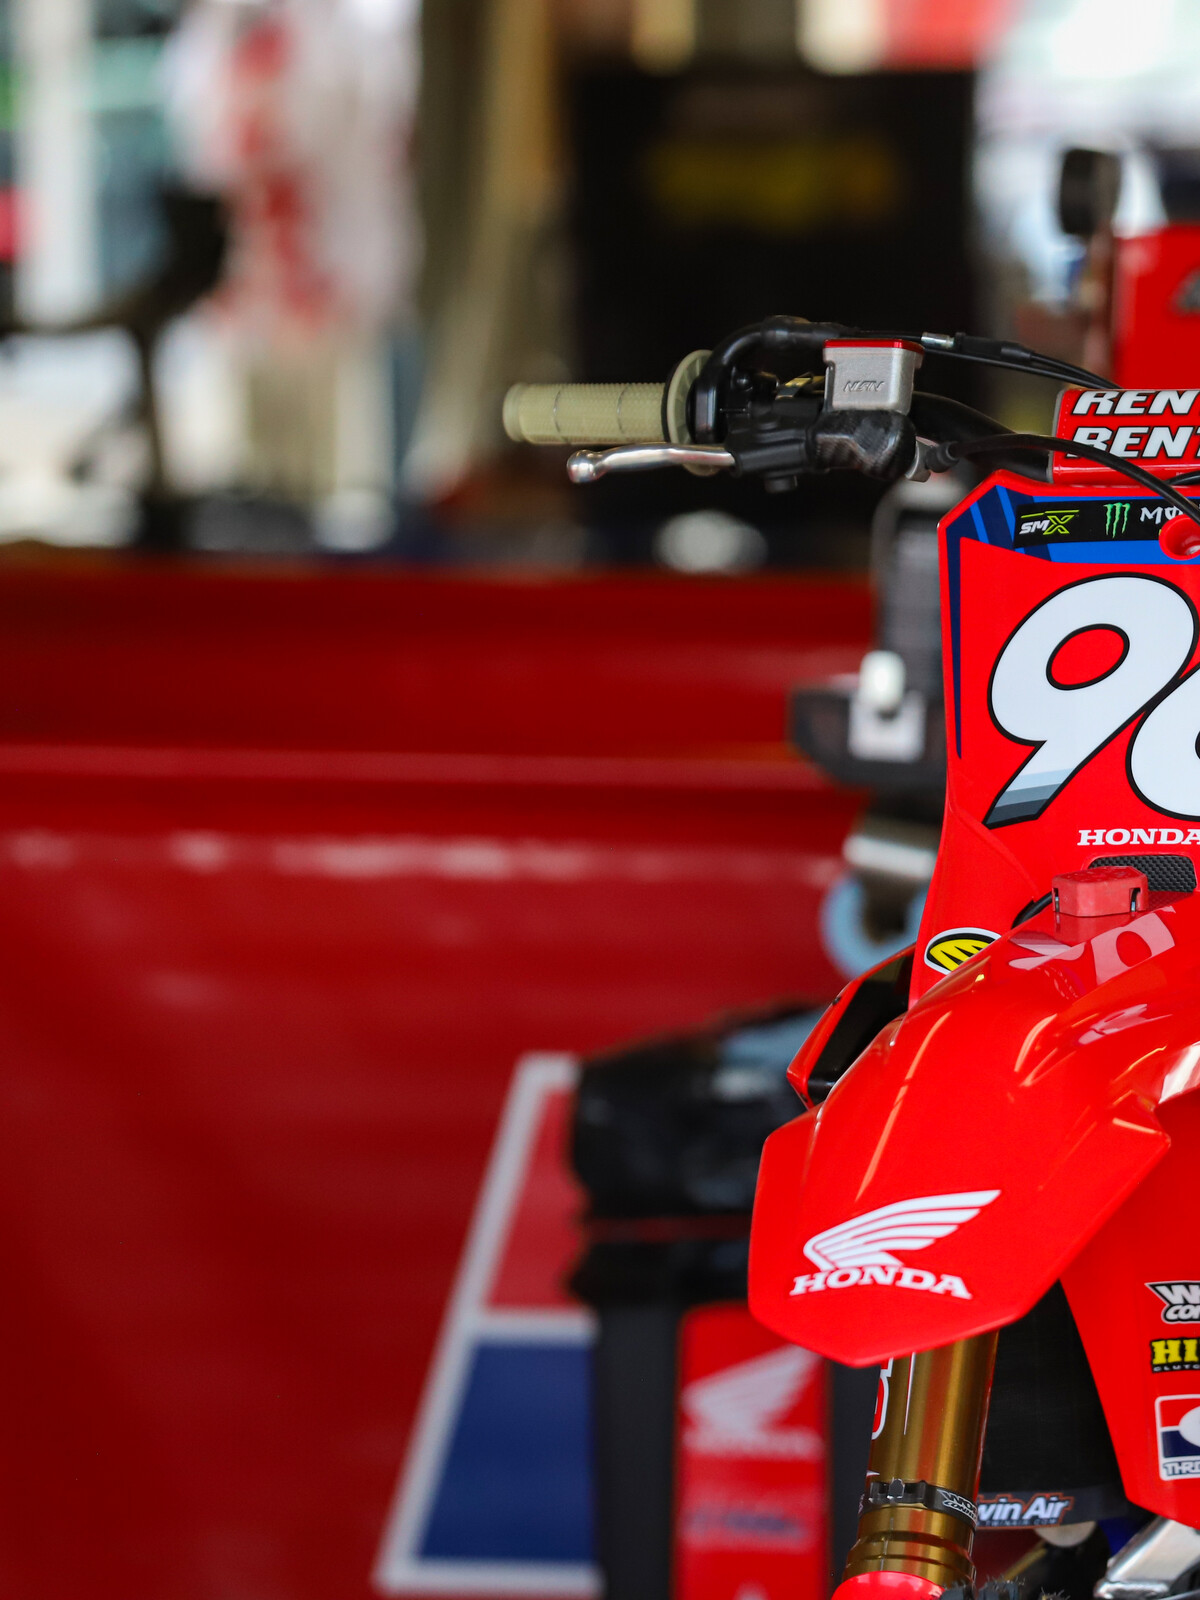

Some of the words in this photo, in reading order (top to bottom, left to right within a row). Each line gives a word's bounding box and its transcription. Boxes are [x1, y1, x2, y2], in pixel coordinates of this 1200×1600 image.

[1018, 514, 1075, 535] SMX
[789, 1265, 973, 1300] HONDA
[1022, 1496, 1069, 1520] Air
